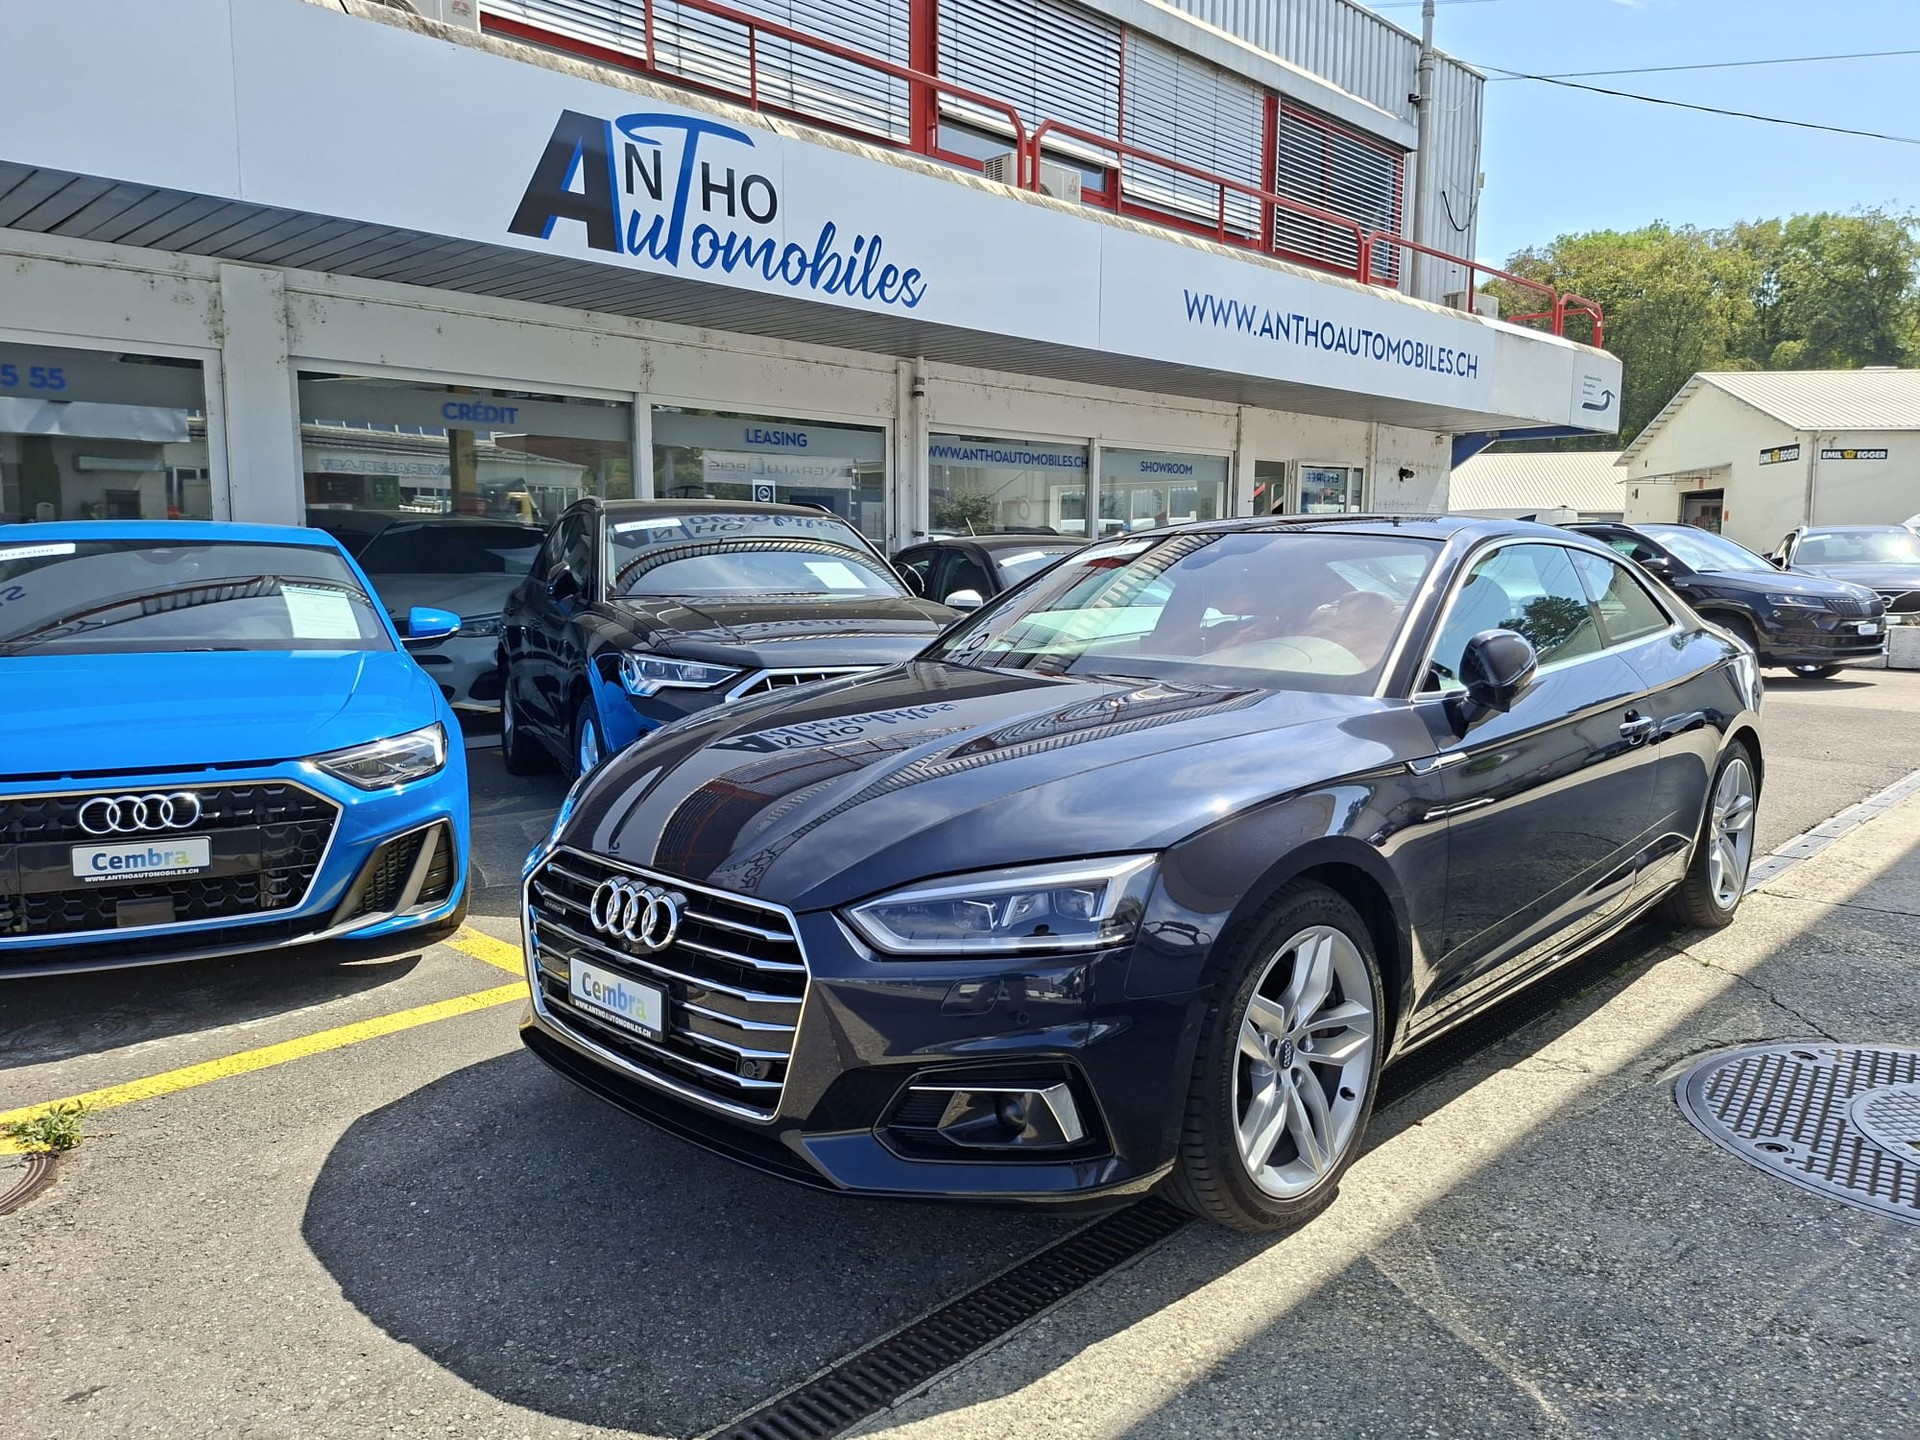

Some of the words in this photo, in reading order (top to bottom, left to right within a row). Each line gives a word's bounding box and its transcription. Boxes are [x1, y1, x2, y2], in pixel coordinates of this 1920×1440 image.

[1183, 288, 1479, 380] WWW.ANTHOAUTOMOBILES.CH
[29, 365, 67, 391] 55
[442, 400, 519, 424] CRÉDIT
[746, 428, 808, 448] LEASING
[928, 445, 1089, 469] WWW.ANTHOAUTOMOBILES.CH
[1780, 448, 1799, 461] EGGER
[1857, 451, 1887, 460] EGGER
[1140, 460, 1193, 475] SHOWROOM
[91, 847, 190, 871] Cembra
[84, 868, 200, 883] WWW.ANTHOAUTOMOBILES.CH
[582, 971, 648, 1020] Cembra
[574, 999, 652, 1038] WWW.ANTHOAUTOMOBILES.CH
